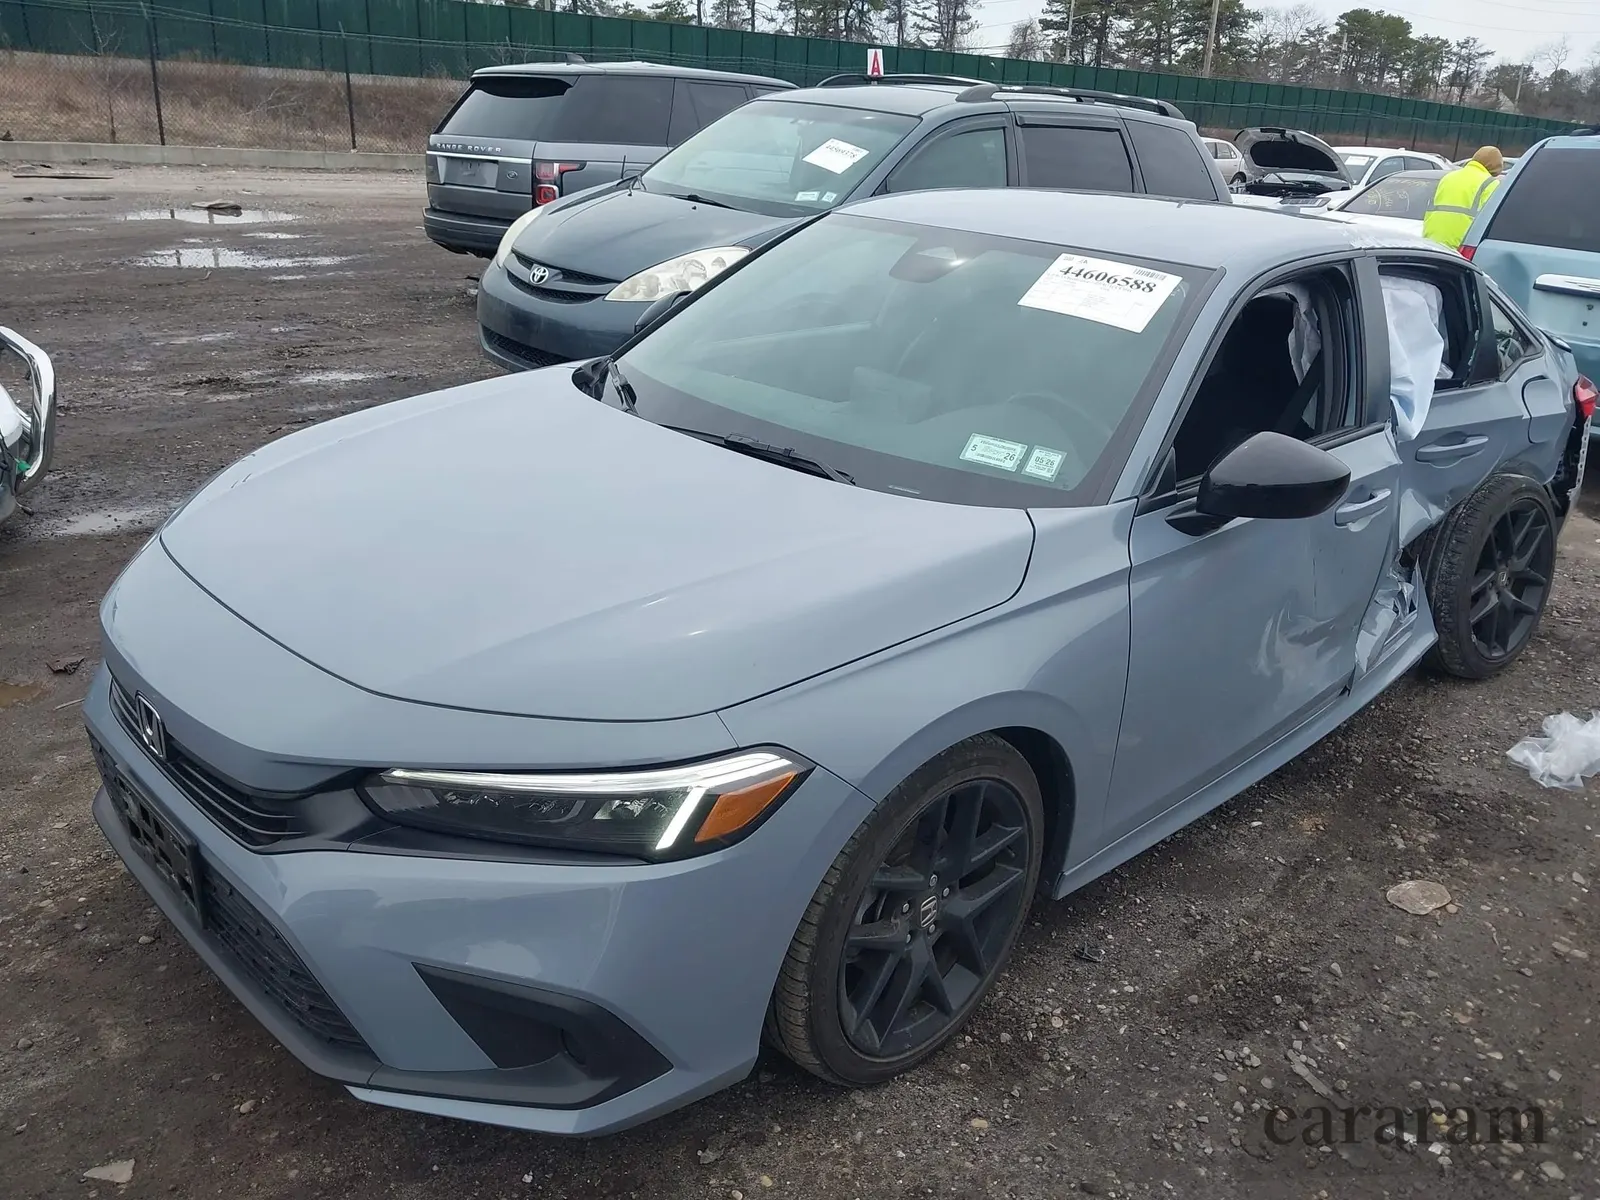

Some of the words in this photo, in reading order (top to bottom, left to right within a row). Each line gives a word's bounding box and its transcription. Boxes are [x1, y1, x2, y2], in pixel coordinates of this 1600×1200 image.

[871, 50, 881, 75] A
[436, 143, 463, 151] RANGE
[467, 145, 502, 153] ROVER
[1059, 265, 1157, 294] 44606588
[970, 443, 979, 452] 5
[1003, 452, 1016, 462] 26
